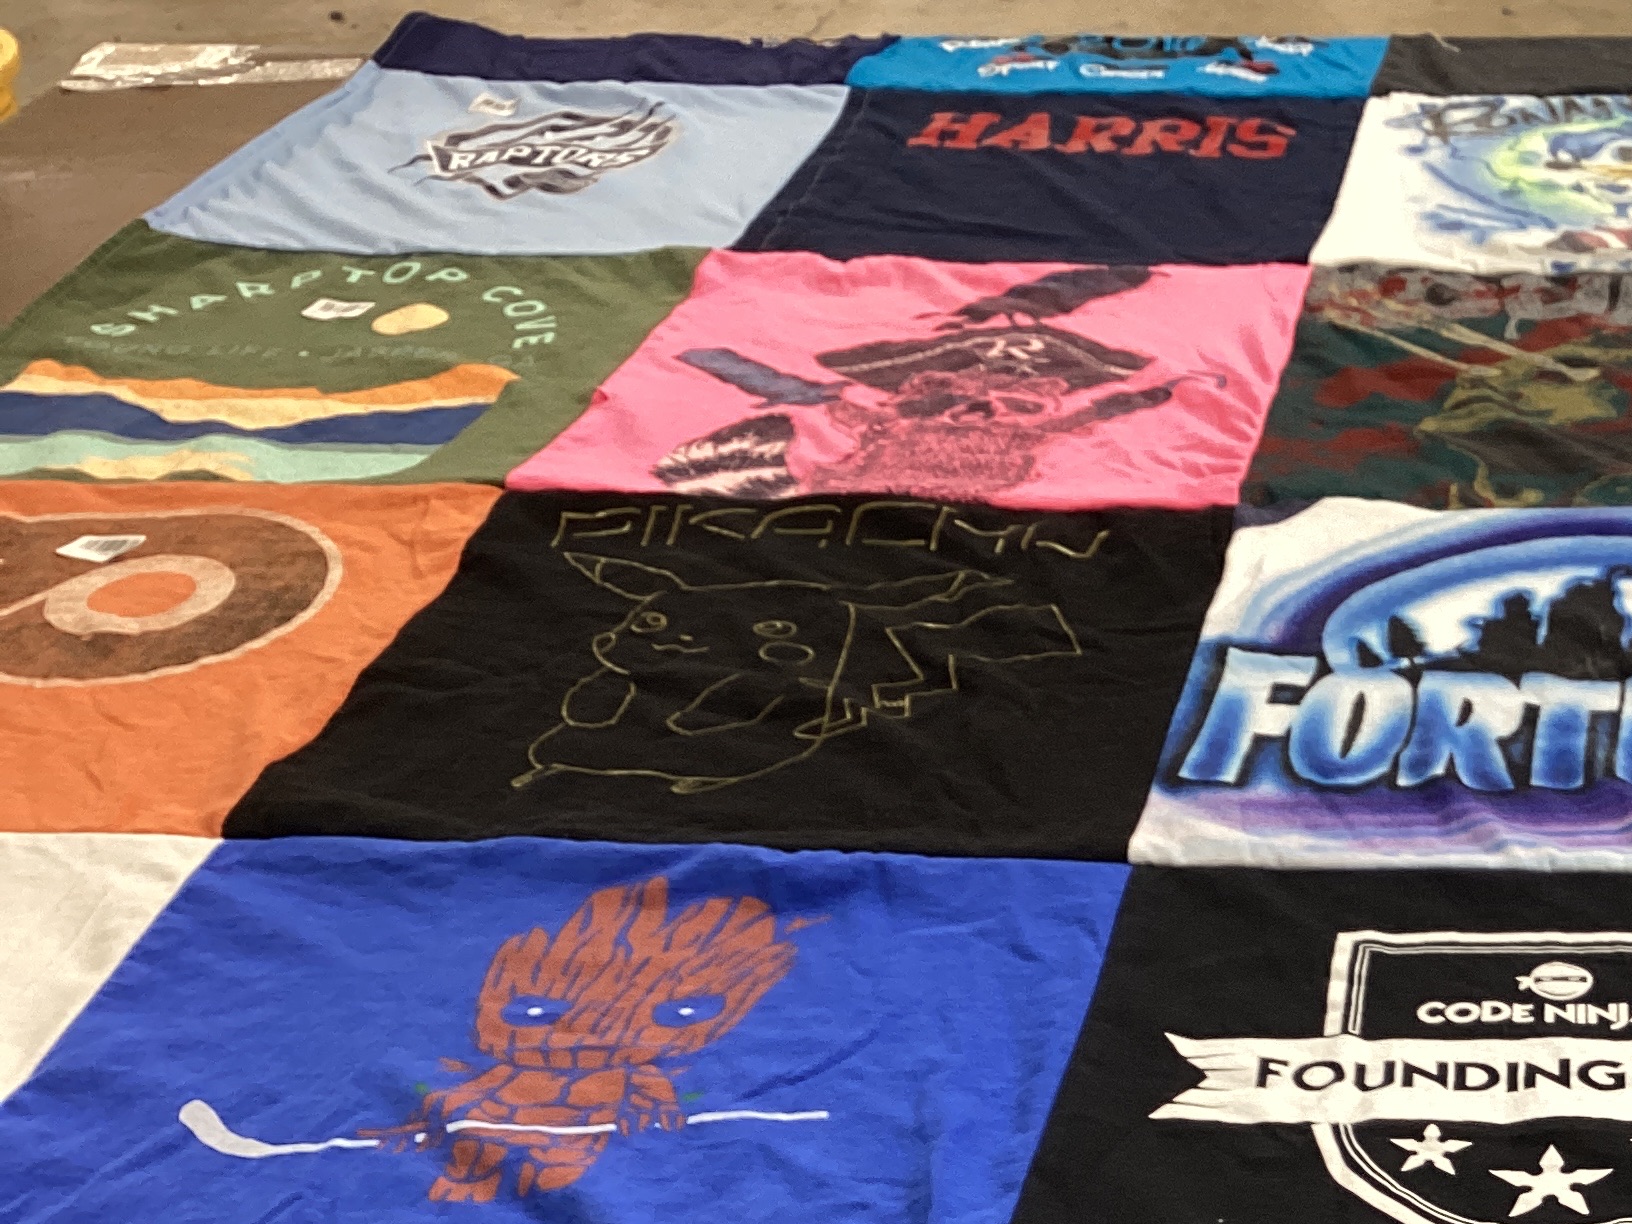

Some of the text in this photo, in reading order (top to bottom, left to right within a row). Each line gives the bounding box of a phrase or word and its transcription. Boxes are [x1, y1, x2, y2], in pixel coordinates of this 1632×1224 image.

[907, 111, 1297, 160] HARRIS
[447, 144, 653, 171] RAPTORS
[90, 261, 558, 349] SHARPTOP COVE
[1416, 1000, 1535, 1025] CODE
[1254, 1056, 1627, 1095] FOUNDING
